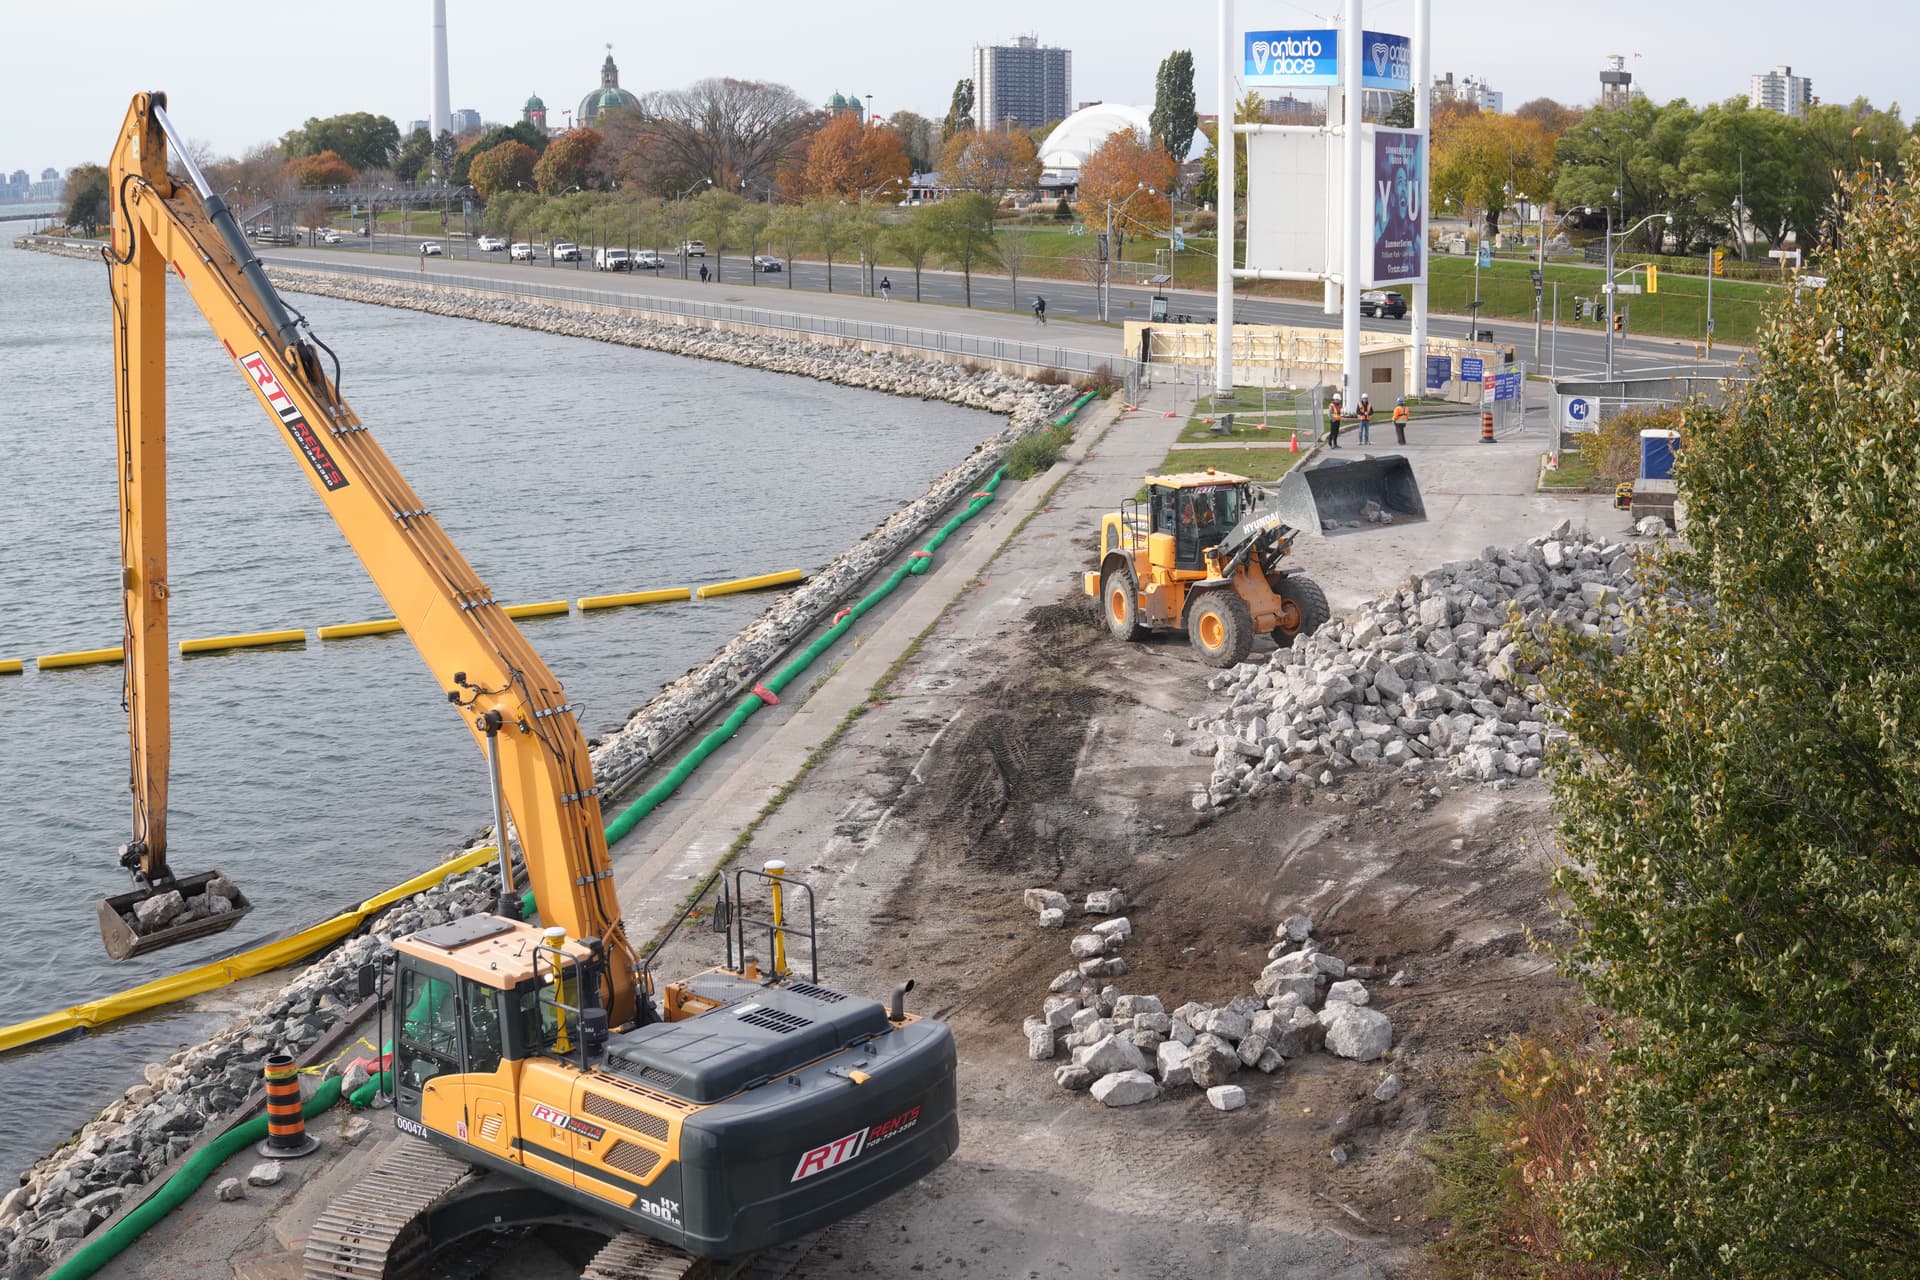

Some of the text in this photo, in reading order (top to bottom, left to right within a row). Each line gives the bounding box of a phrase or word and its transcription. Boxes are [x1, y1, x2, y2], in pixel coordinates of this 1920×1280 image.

[1271, 36, 1321, 56] ontario
[1273, 51, 1316, 79] place
[246, 358, 342, 484] RTI RENTS
[1243, 511, 1279, 534] HYUNDAI
[535, 1105, 567, 1126] RTI
[397, 1117, 427, 1139] 000474
[797, 1105, 920, 1178] RTI RENTS
[660, 1196, 679, 1213] HX
